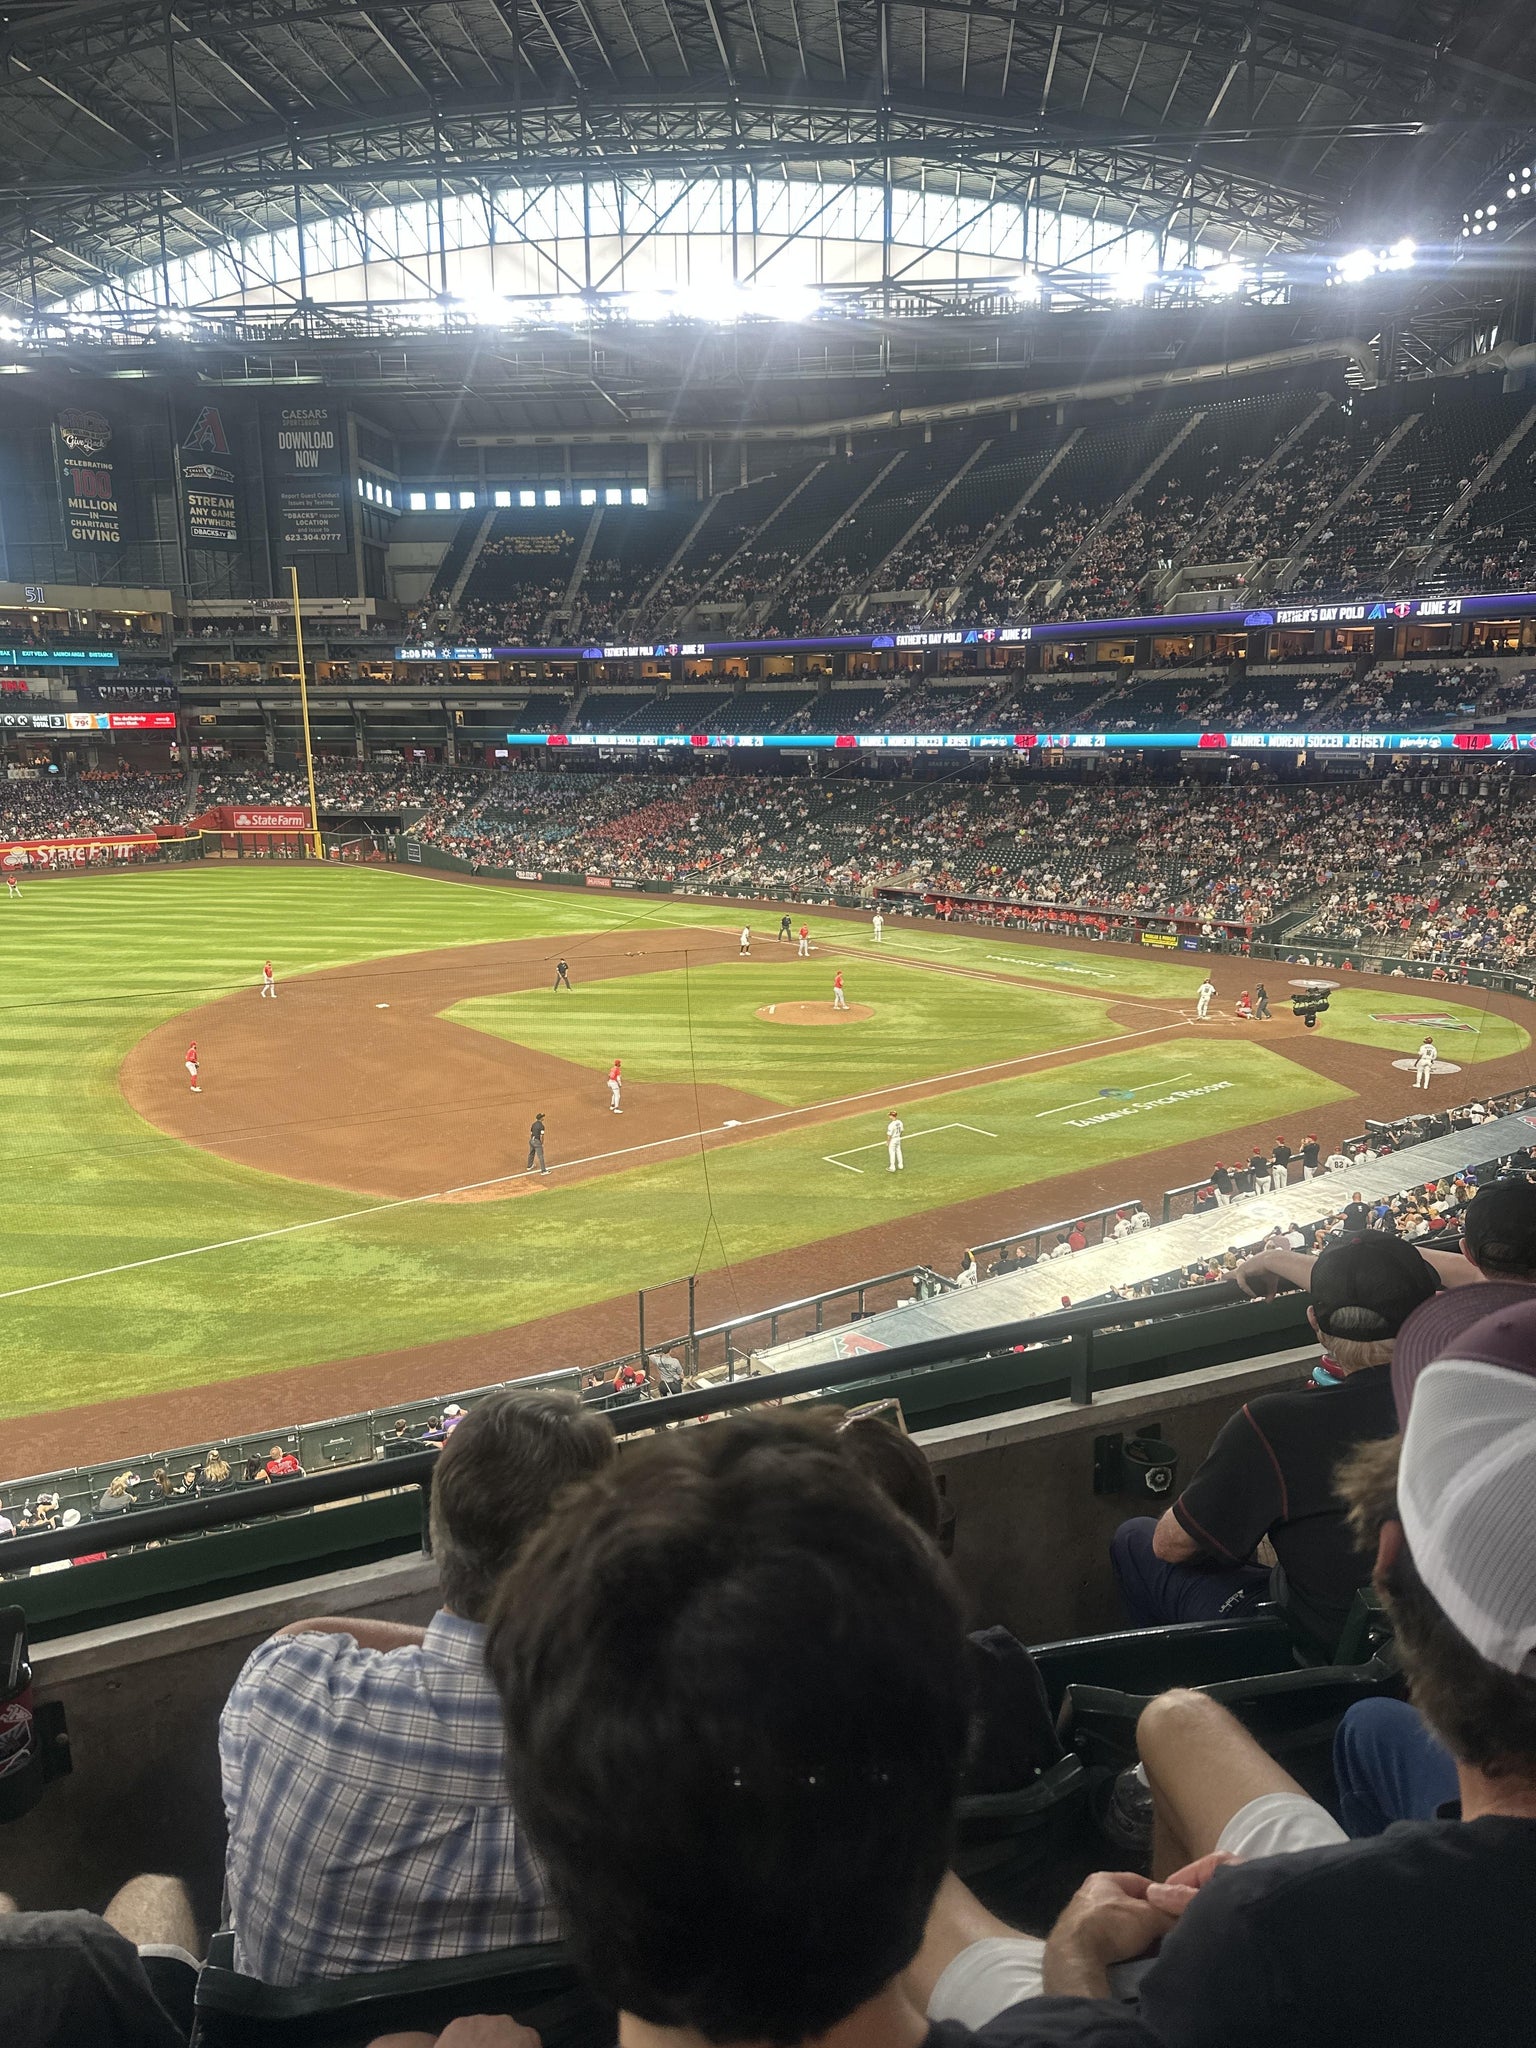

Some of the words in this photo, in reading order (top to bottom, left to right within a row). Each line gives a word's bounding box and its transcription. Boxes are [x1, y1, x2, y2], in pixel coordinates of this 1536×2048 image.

[281, 409, 328, 419] CAESARS
[278, 431, 334, 450] DOWNLOAD
[64, 459, 113, 470] CELEBRATING
[295, 450, 319, 468] NOW
[63, 467, 113, 499] $100
[68, 498, 118, 511] MILLION
[188, 495, 235, 509] STREAM
[89, 511, 99, 519] IN
[190, 507, 208, 516] ANY
[211, 509, 236, 519] GAME
[70, 519, 119, 530] CHARITABLE
[190, 517, 236, 528] ANYWHERE
[72, 528, 120, 542] GIVING
[285, 533, 341, 541] 623.304.0777
[24, 586, 46, 604] 51
[1276, 608, 1318, 624] FATHER'S
[1319, 608, 1339, 622] DAY
[1339, 606, 1365, 620] POLO
[1416, 601, 1445, 616] JUNE
[1447, 600, 1461, 614] 21
[999, 628, 1021, 641] JUNE
[1021, 628, 1031, 640] 21
[421, 649, 437, 658] PM
[54, 717, 61, 726] 3
[1230, 735, 1266, 748] GABRIEL
[1268, 735, 1305, 748] MORENO
[1307, 735, 1344, 748] SOCCER
[1345, 735, 1385, 749] JERSEY
[1466, 735, 1478, 750] 14
[252, 814, 277, 826] State
[277, 814, 302, 826] Farm
[35, 844, 86, 864] State
[1132, 1095, 1180, 1111] STICK
[1334, 1160, 1344, 1169] 82
